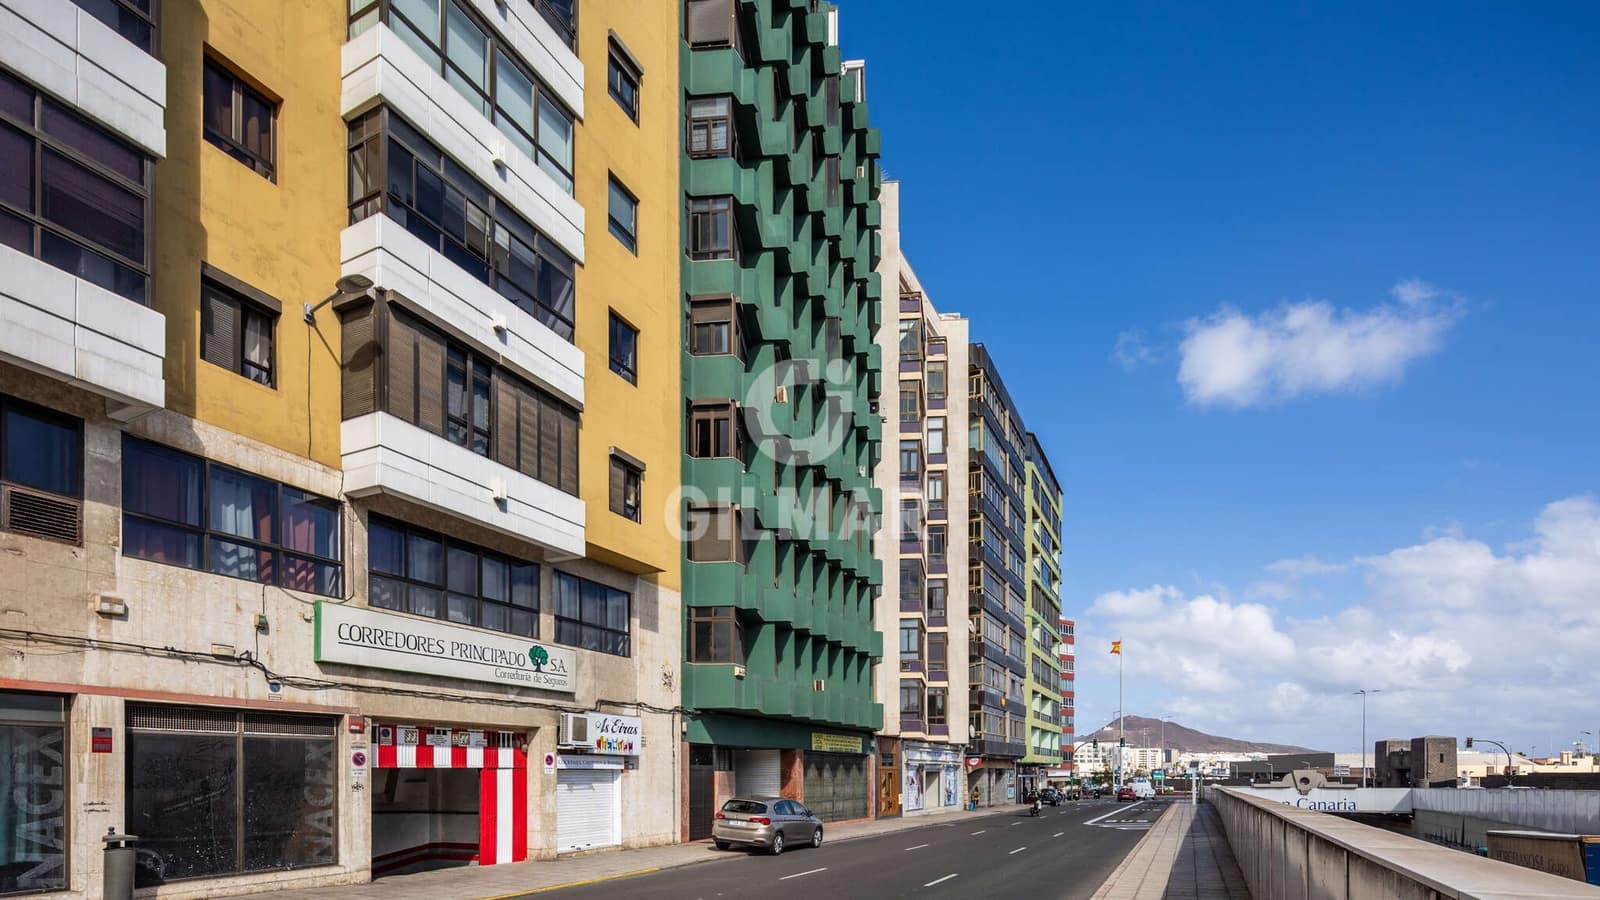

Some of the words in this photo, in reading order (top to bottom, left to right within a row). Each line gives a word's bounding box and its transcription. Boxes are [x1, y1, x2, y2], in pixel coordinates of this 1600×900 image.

[337, 622, 445, 655] CORREDORES
[451, 641, 526, 668] PRINCIPADO
[550, 658, 568, 674] S.A.
[533, 673, 542, 683] de
[543, 674, 568, 688] Seguros
[611, 718, 638, 735] Eiras
[1296, 797, 1356, 811] Canaria
